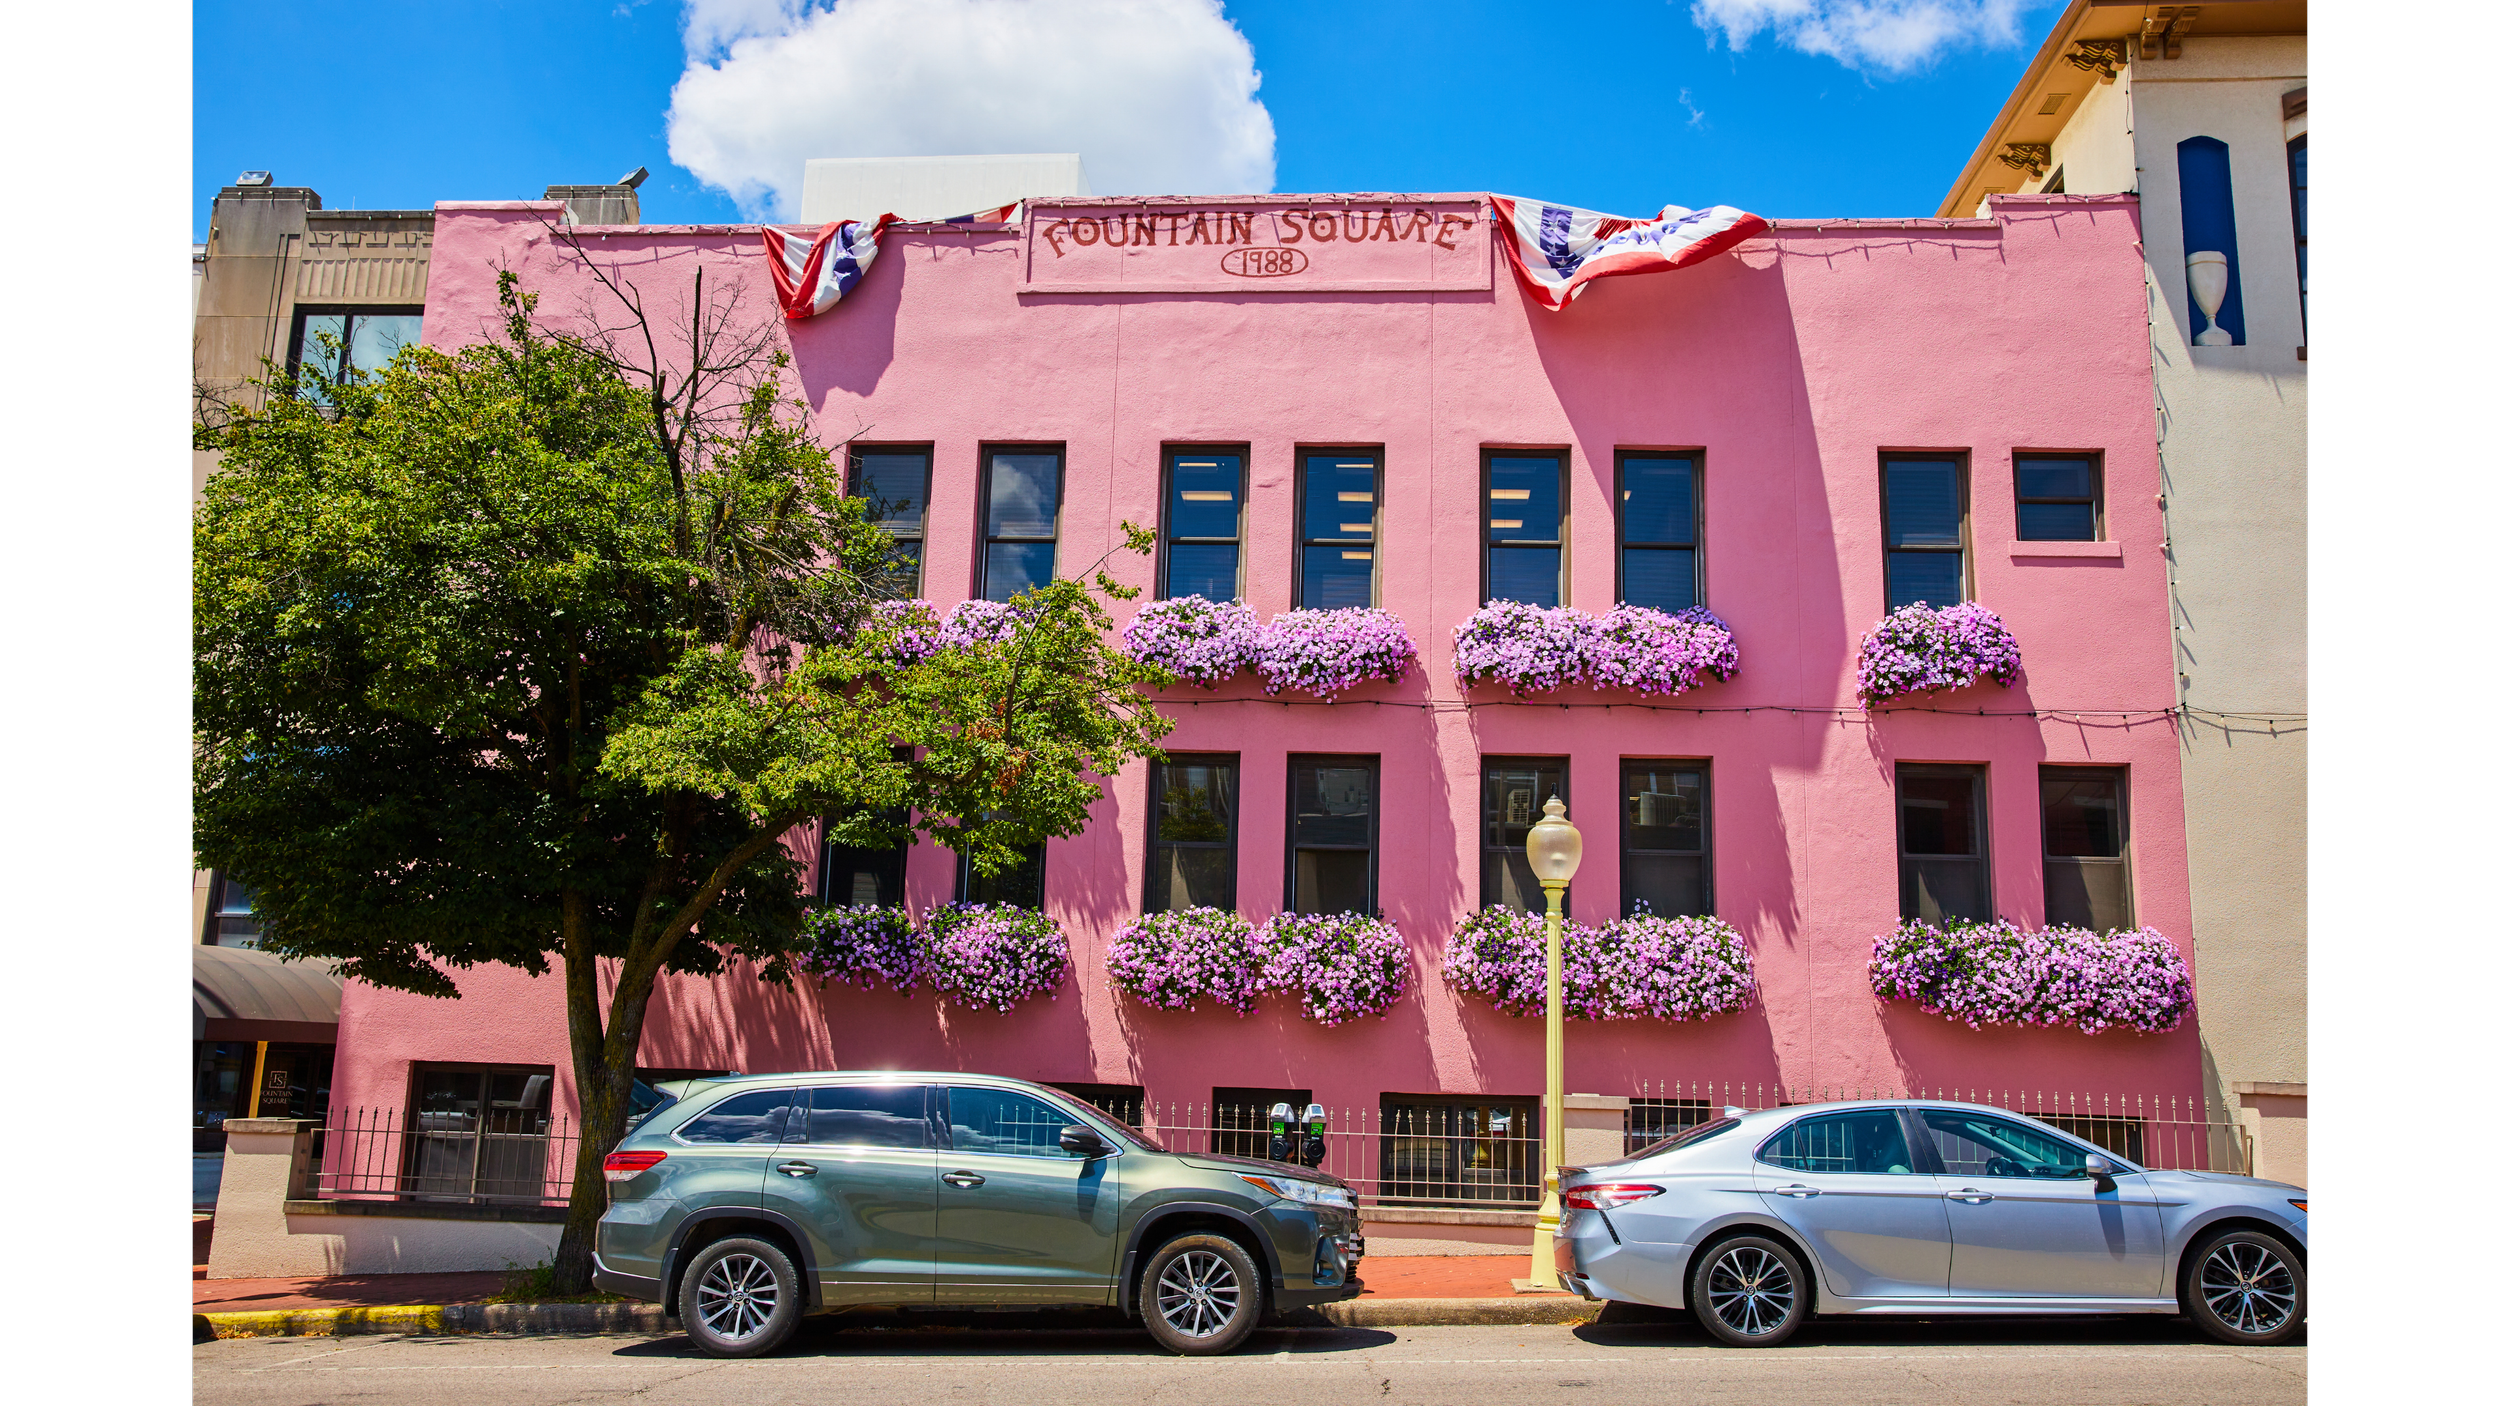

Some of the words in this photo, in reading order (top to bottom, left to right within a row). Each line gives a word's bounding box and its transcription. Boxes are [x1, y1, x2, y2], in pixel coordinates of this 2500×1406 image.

[1042, 210, 1255, 259] FOUNTAIN
[1280, 208, 1473, 251] SQUARE
[1242, 250, 1293, 275] 1988
[262, 1097, 289, 1105] SQUARE
